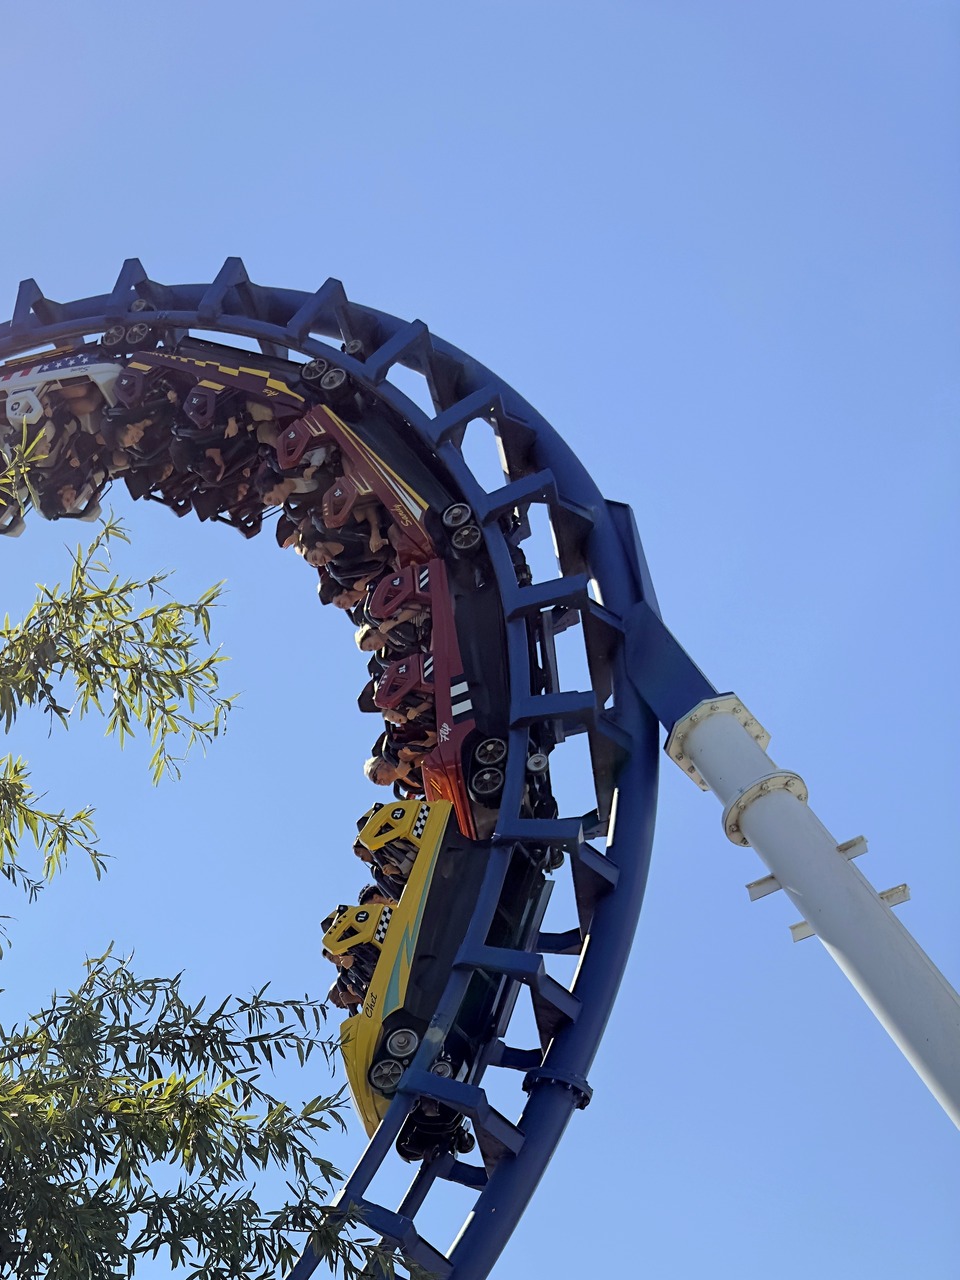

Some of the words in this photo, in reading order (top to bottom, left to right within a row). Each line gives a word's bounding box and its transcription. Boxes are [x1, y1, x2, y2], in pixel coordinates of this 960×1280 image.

[390, 503, 413, 527] Sandy
[439, 722, 452, 743] Flip
[393, 809, 403, 819] 2L
[357, 912, 367, 922] 1L
[365, 992, 378, 1019] Chet
